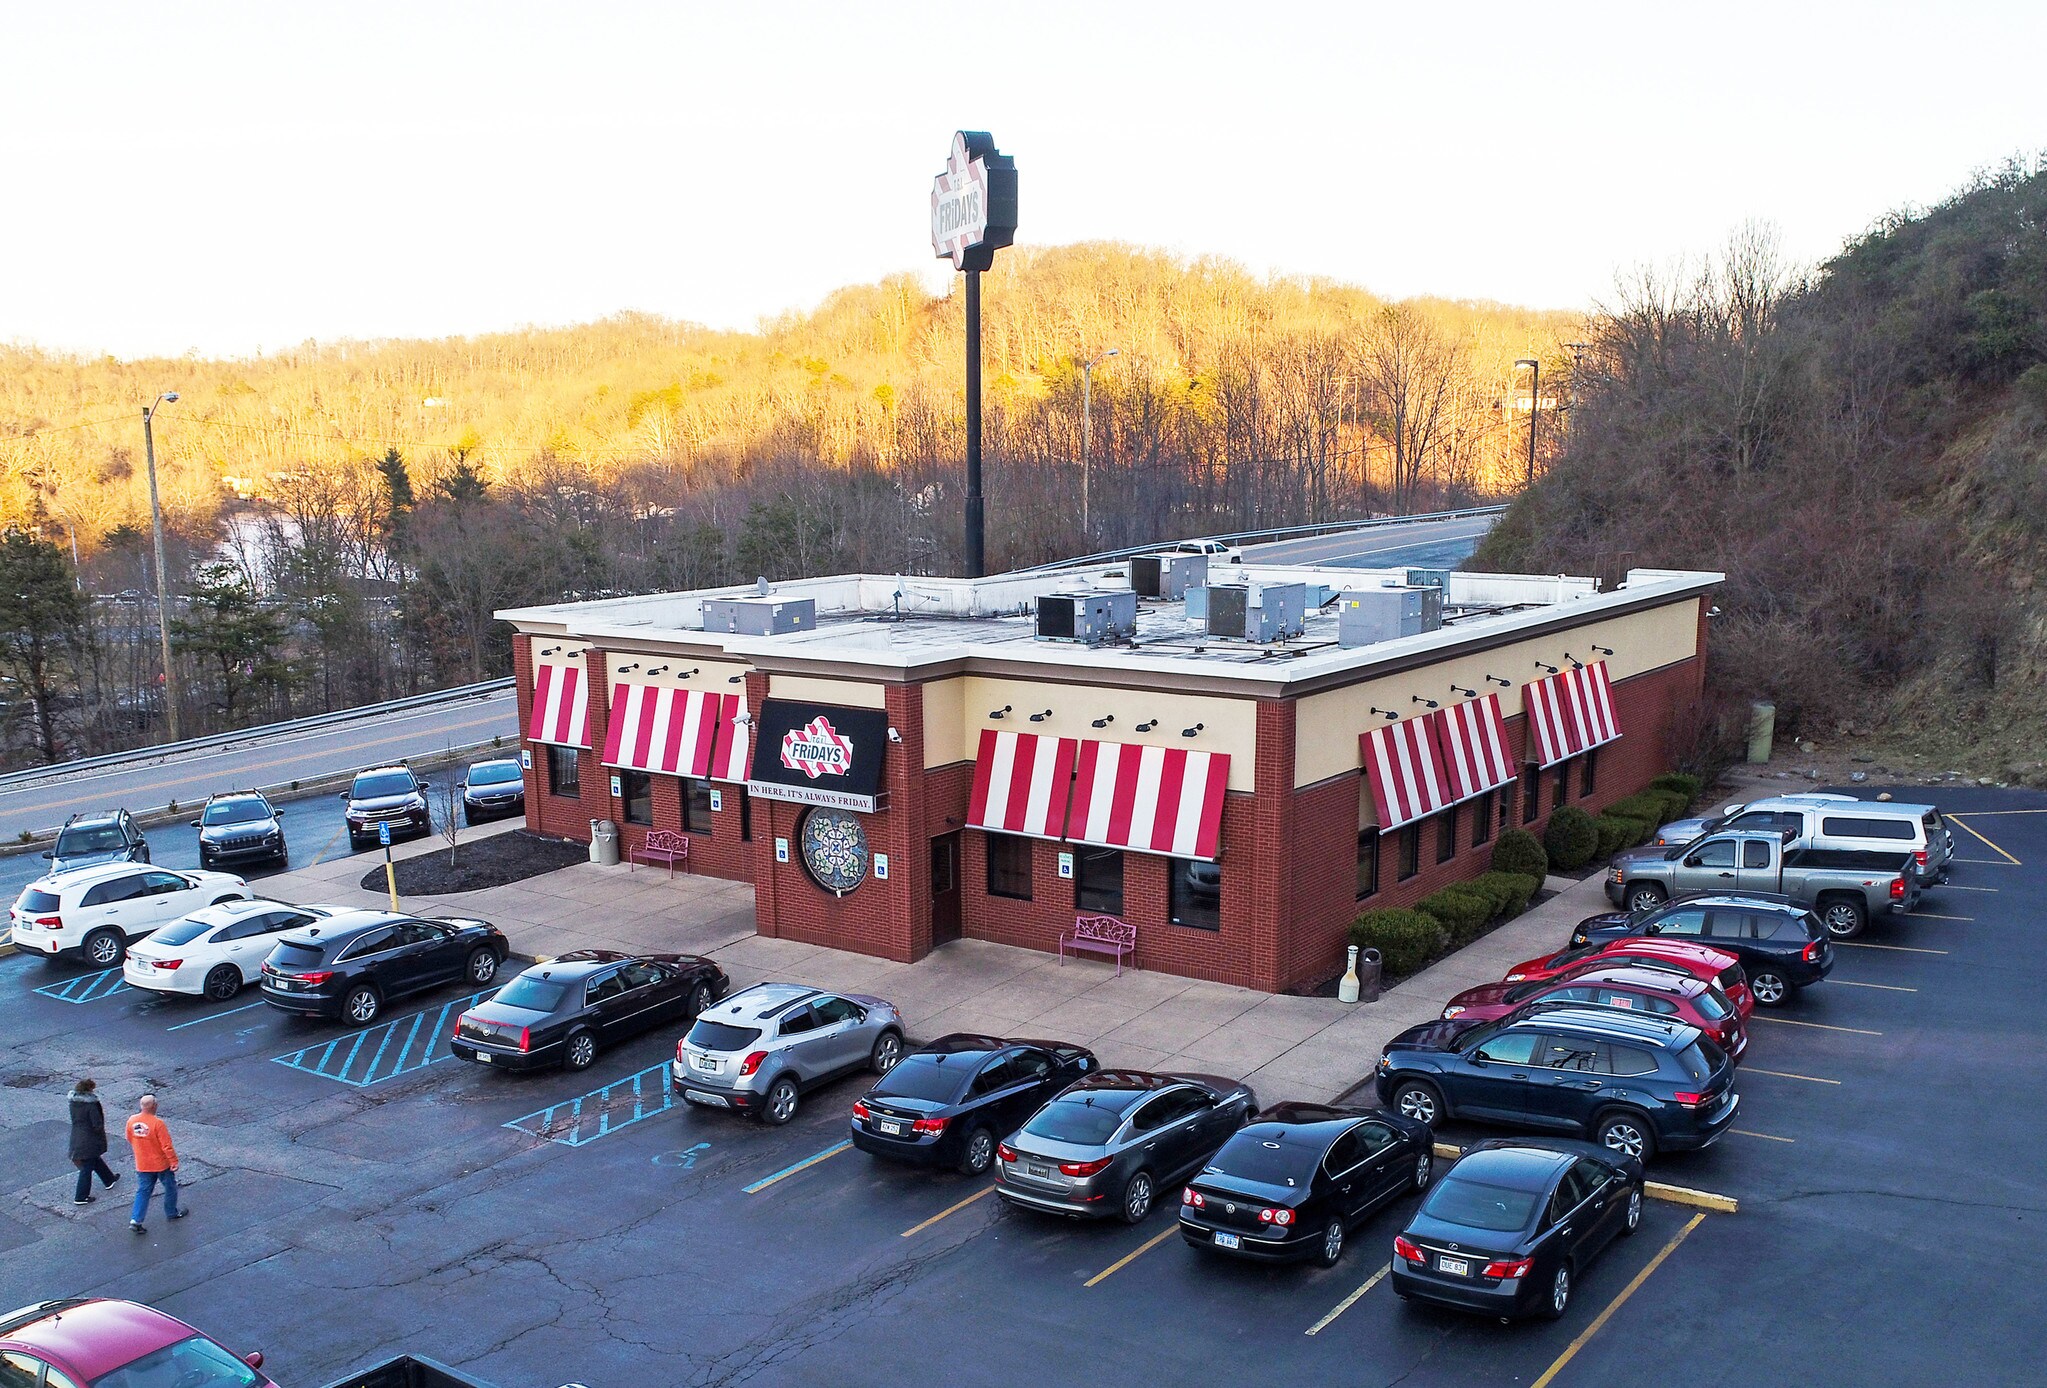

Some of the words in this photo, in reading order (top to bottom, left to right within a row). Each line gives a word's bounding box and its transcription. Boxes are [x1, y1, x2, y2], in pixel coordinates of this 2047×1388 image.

[750, 784, 759, 792] IN
[761, 786, 786, 797] HERE,
[787, 789, 803, 798] IT'S
[804, 792, 836, 804] ALWAYS
[838, 797, 871, 808] FRIDAY.
